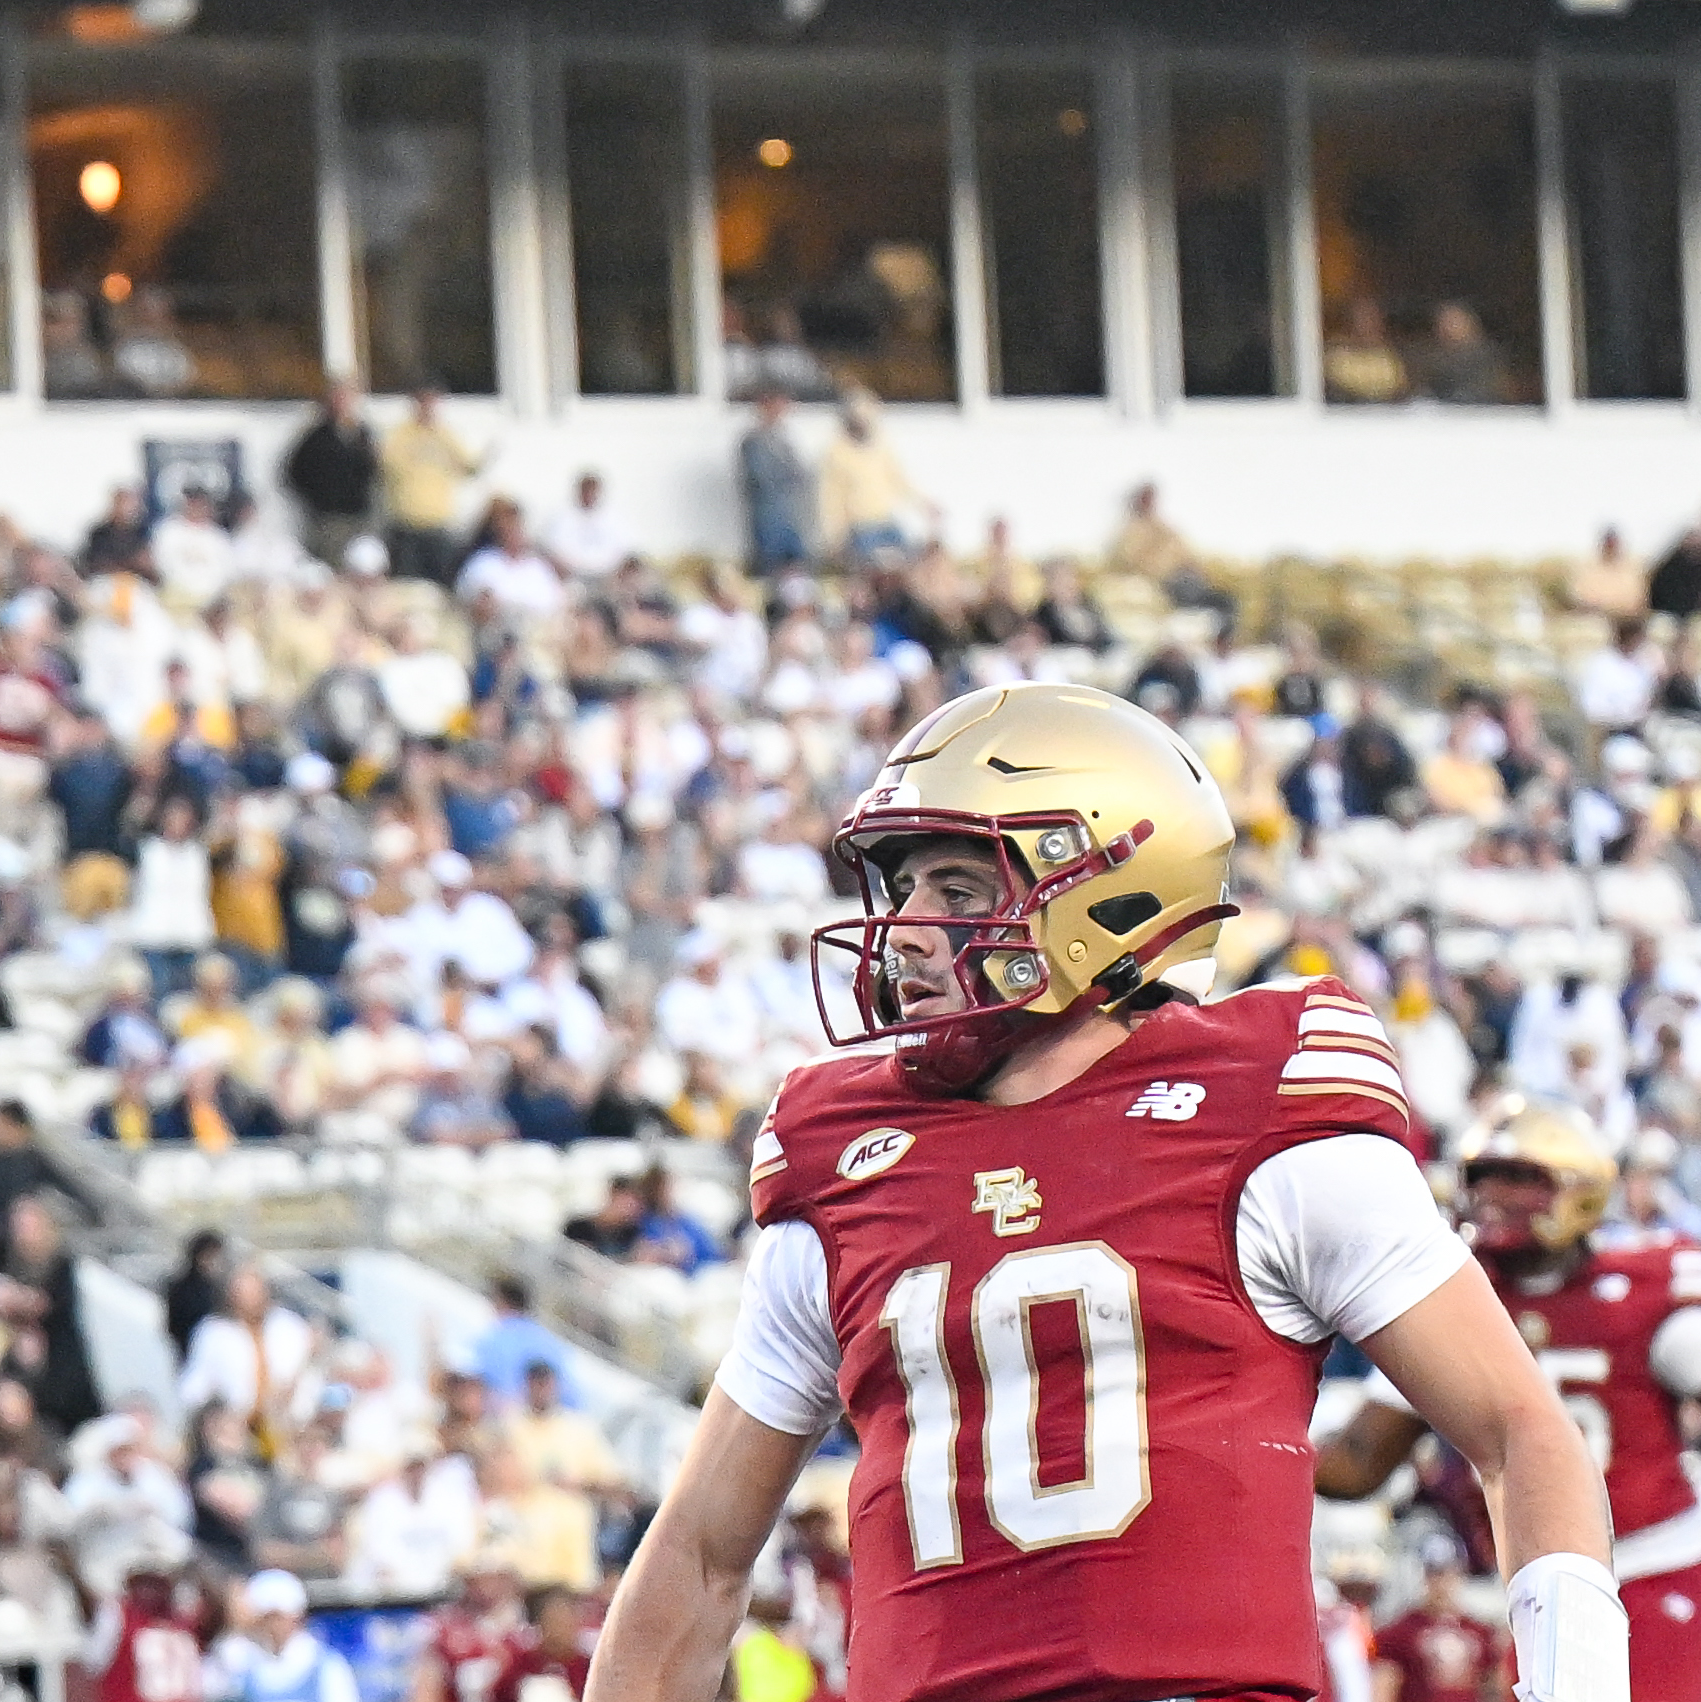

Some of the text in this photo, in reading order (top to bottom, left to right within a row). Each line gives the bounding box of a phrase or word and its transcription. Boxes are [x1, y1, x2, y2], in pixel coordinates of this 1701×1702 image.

[847, 1132, 904, 1173] ACC
[971, 1166, 1043, 1238] BC
[878, 1239, 1153, 1572] 10
